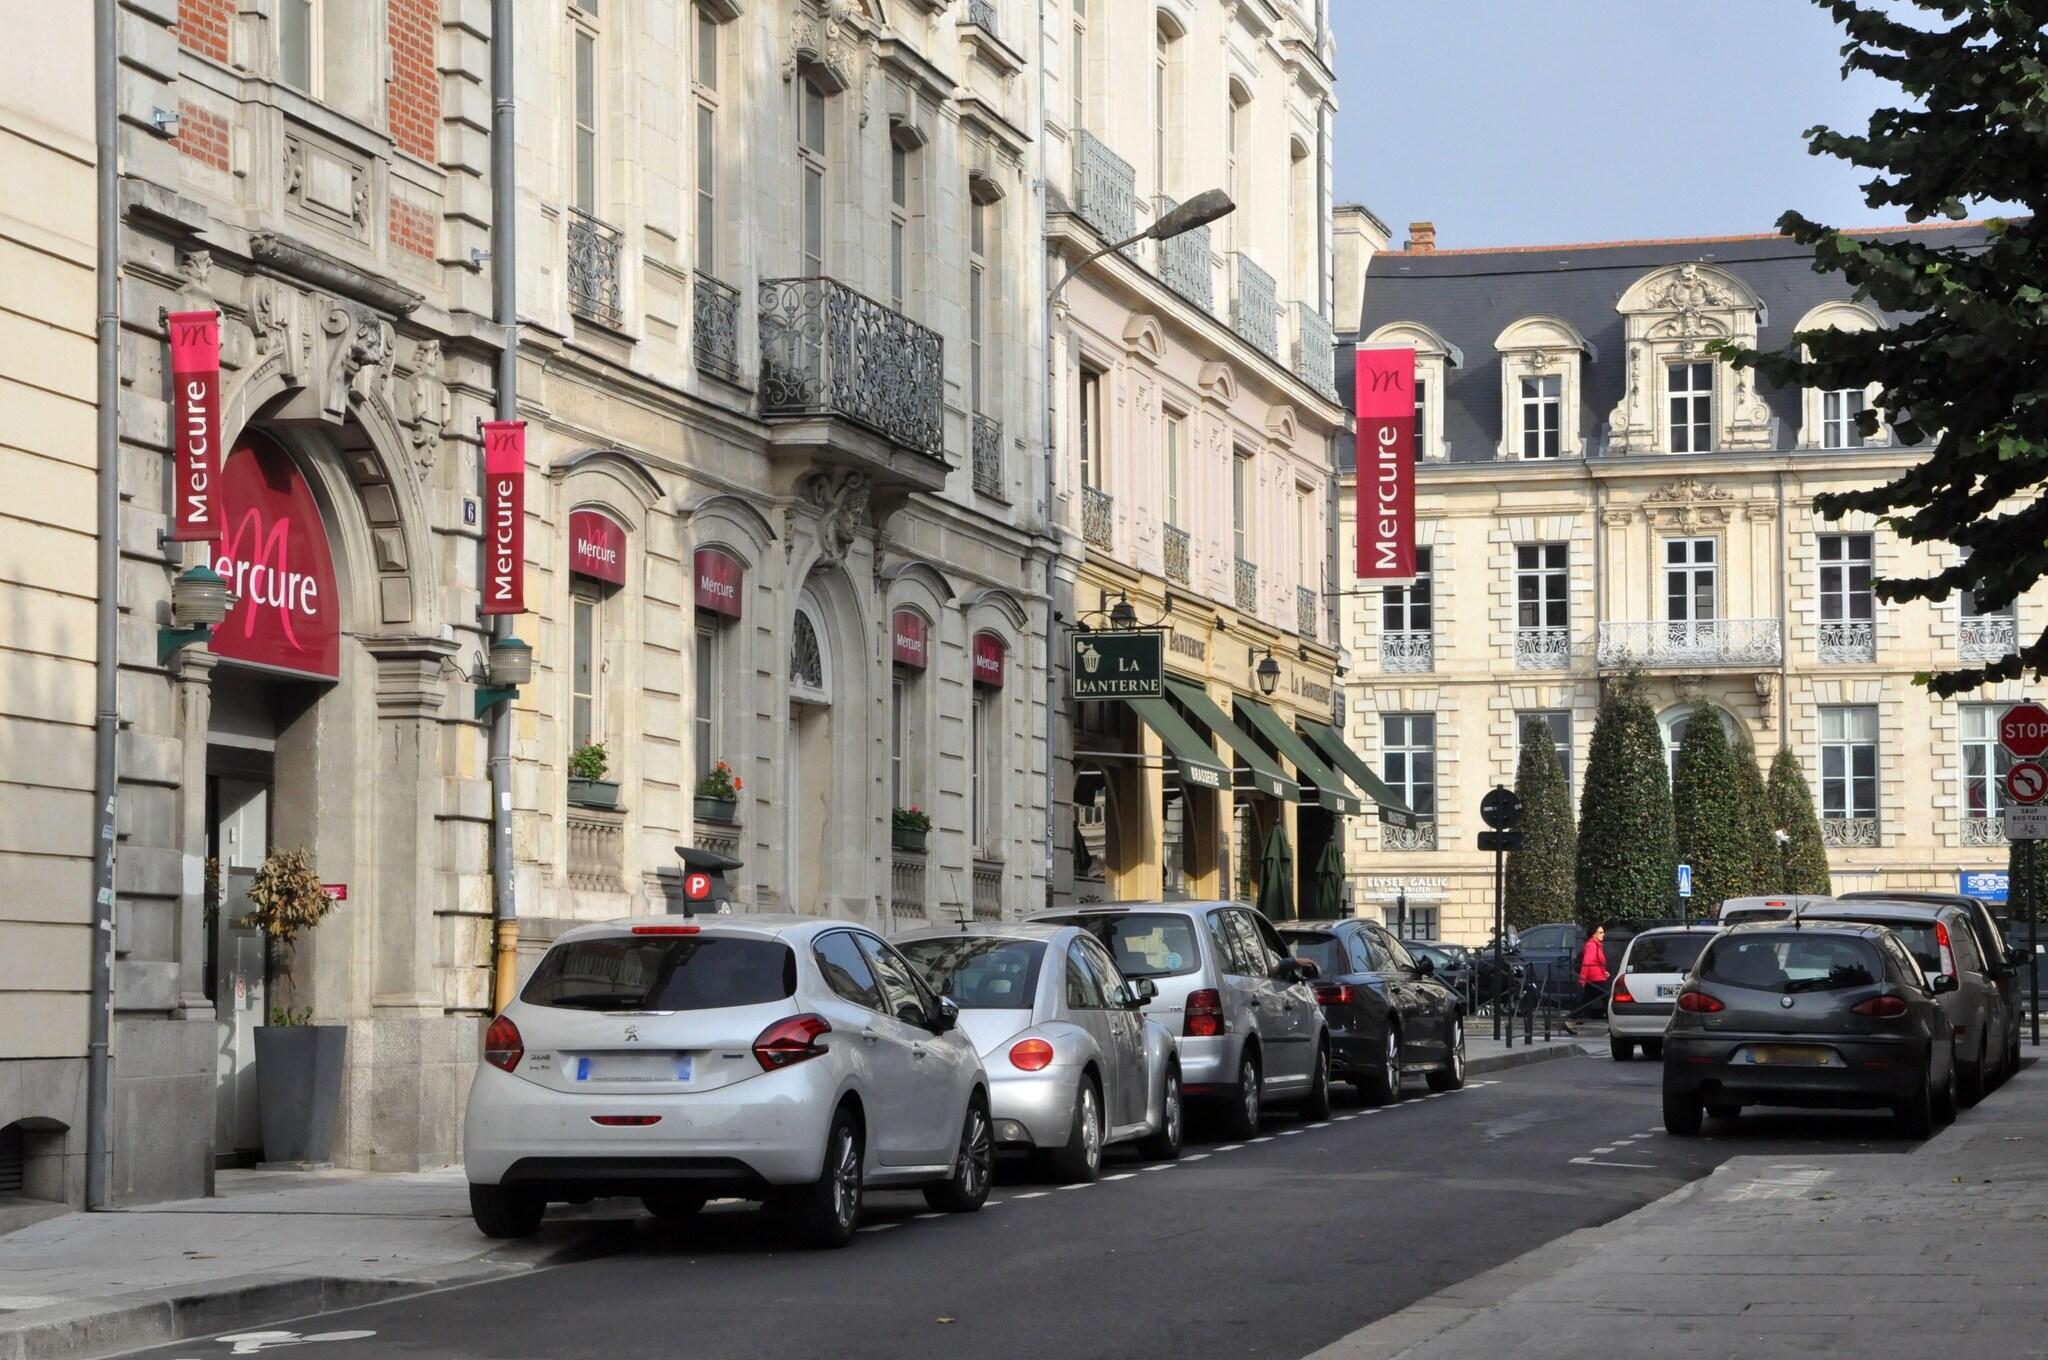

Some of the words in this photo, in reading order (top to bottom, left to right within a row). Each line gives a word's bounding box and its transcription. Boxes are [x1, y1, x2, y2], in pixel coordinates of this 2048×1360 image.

[187, 381, 208, 523] Mercure
[1375, 426, 1398, 569] Mercure
[467, 503, 474, 522] 6
[495, 480, 513, 600] Mercure
[578, 538, 616, 564] Mercure
[206, 545, 318, 615] ercure
[701, 576, 734, 599] Mercure
[896, 633, 921, 652] Mercure
[976, 655, 999, 672] Mercure
[1118, 657, 1140, 672] LA
[1076, 678, 1159, 693] LANTERNE
[2005, 723, 2048, 738] STOP
[1190, 766, 1220, 787] BRASSERIE
[1273, 781, 1283, 796] BAR
[692, 877, 705, 894] P
[1410, 877, 1449, 887] GALLIC
